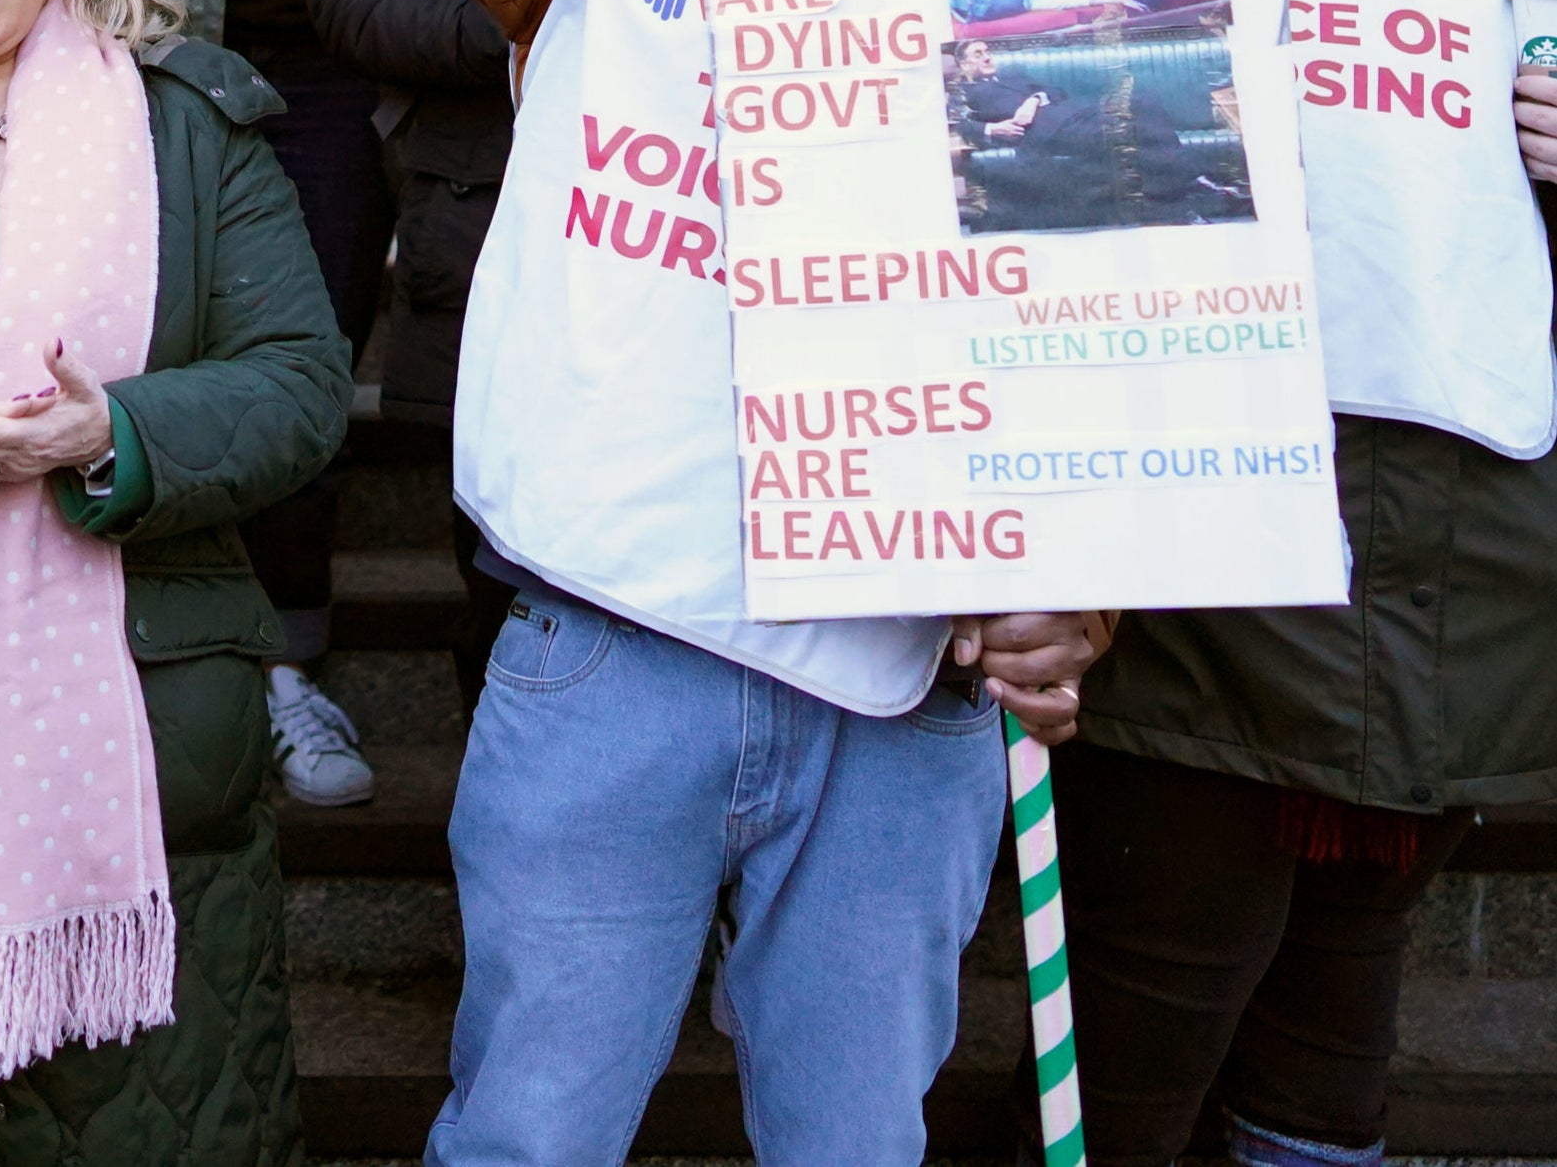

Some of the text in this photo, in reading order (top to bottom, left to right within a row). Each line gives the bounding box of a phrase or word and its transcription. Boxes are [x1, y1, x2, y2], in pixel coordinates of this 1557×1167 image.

[733, 13, 929, 72] DYING
[1383, 9, 1471, 62] OF
[724, 77, 899, 134] GOVT
[732, 157, 783, 207] IS
[732, 246, 1028, 308] SLEEPING
[1015, 282, 1303, 326] WAKE UP NOW!
[969, 318, 1307, 365] LISTEN TO PEOPLE!
[744, 381, 992, 444] NURSES
[750, 448, 871, 500] ARE
[968, 444, 1323, 482] PROTECT OUR NHS!
[751, 509, 1026, 561] LEAVING
